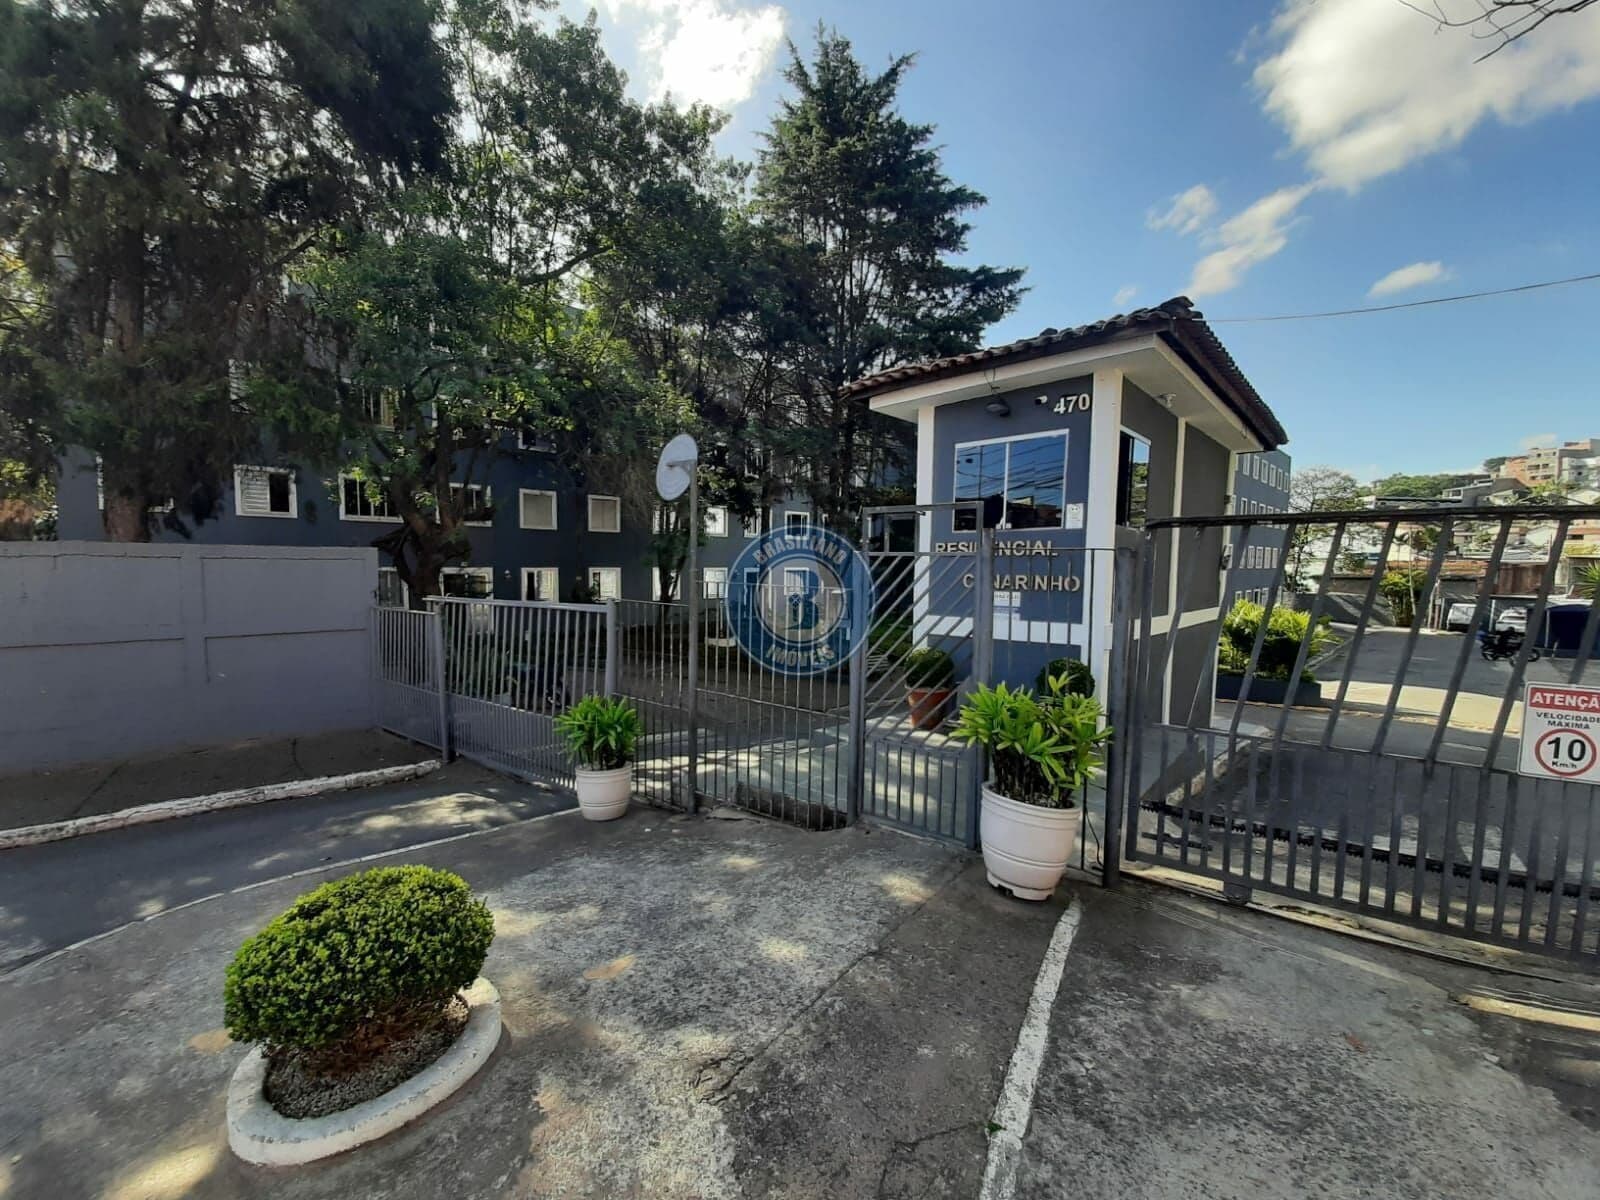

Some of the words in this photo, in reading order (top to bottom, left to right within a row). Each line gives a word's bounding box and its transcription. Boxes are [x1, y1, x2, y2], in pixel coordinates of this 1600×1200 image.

[1053, 393, 1090, 414] 470
[935, 540, 1058, 557] RESINCIAL
[963, 573, 1081, 592] CNARINHO
[1531, 692, 1600, 710] ATENÇÃ
[1547, 736, 1587, 762] 10
